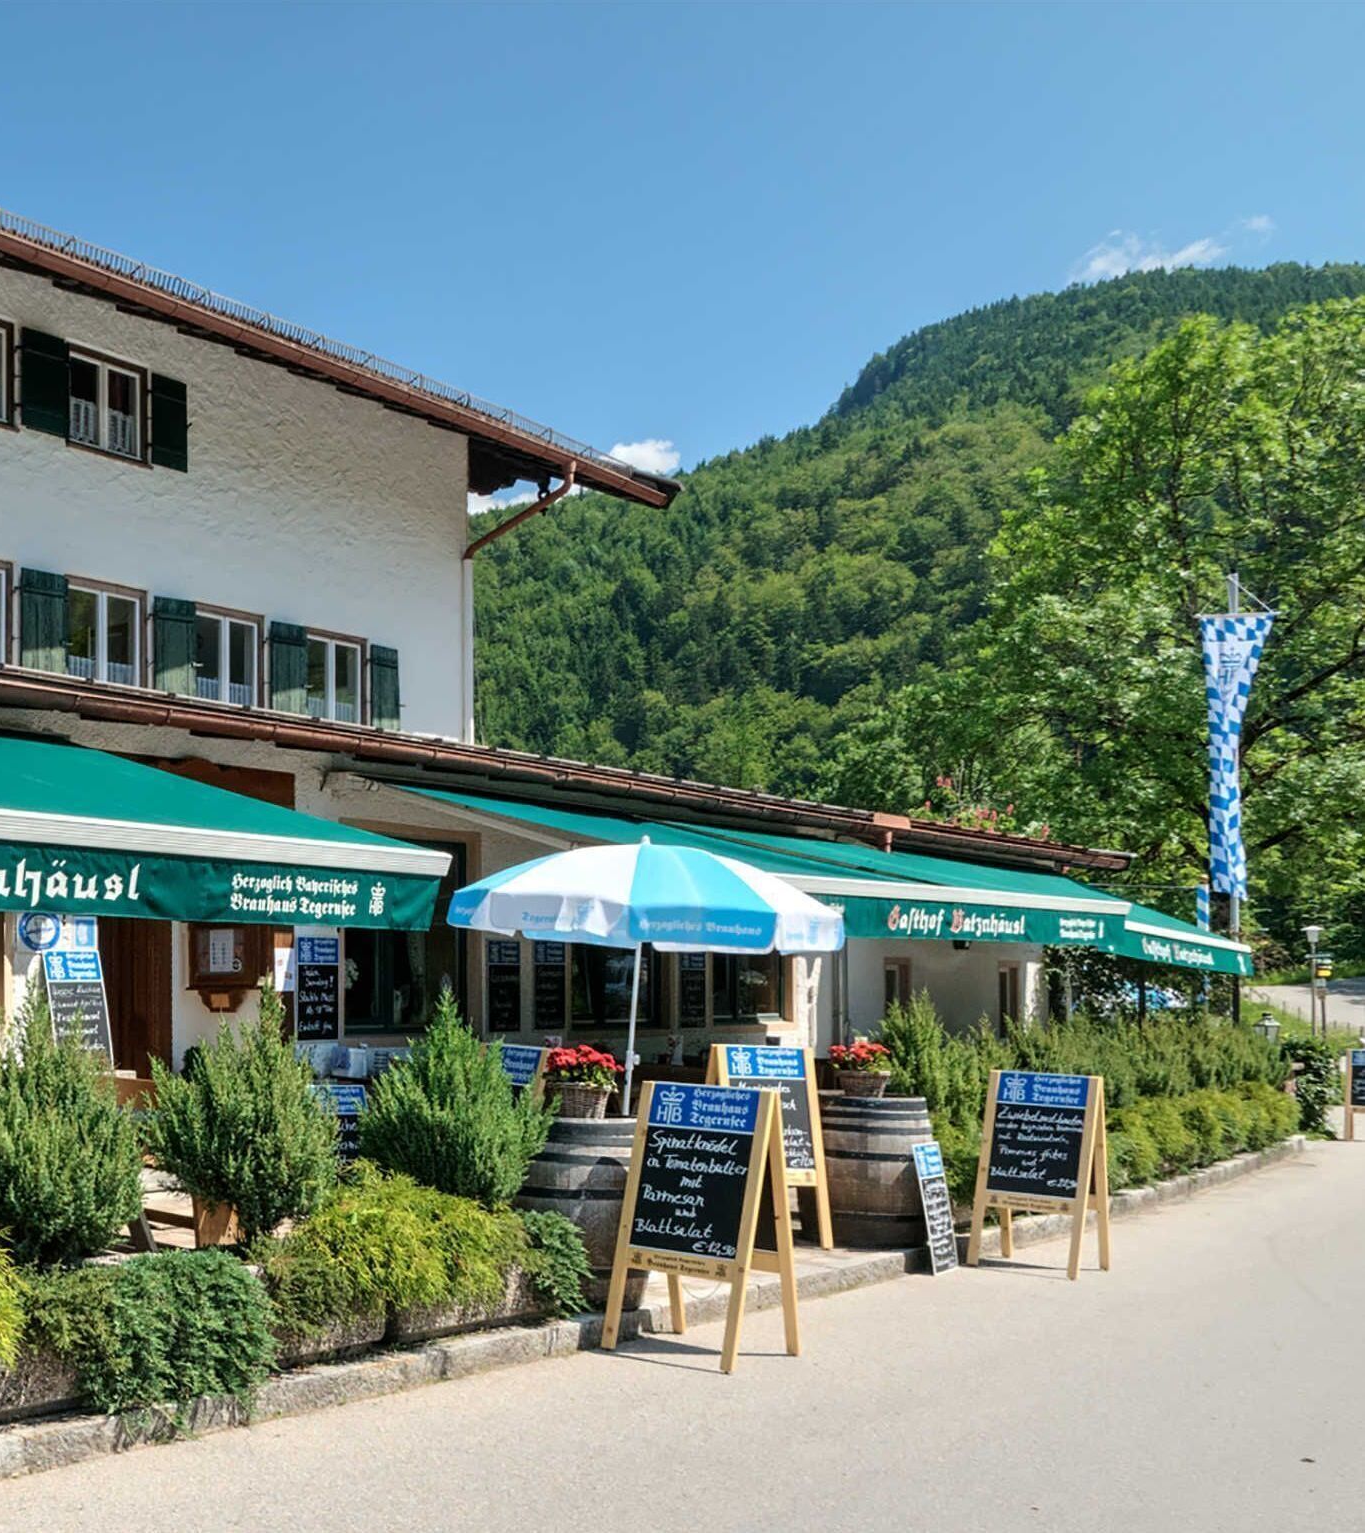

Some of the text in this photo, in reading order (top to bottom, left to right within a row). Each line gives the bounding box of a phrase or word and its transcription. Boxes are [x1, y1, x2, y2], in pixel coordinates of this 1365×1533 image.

[232, 873, 292, 894] Herzoglich
[231, 893, 297, 915] Brauhaus
[692, 1100, 749, 1116] Brauhaus
[649, 1130, 738, 1156] Spinatknödel
[680, 1175, 703, 1189] mit
[642, 1184, 704, 1207] Parmesan
[674, 1207, 697, 1218] und
[635, 1218, 714, 1238] Blattsalat
